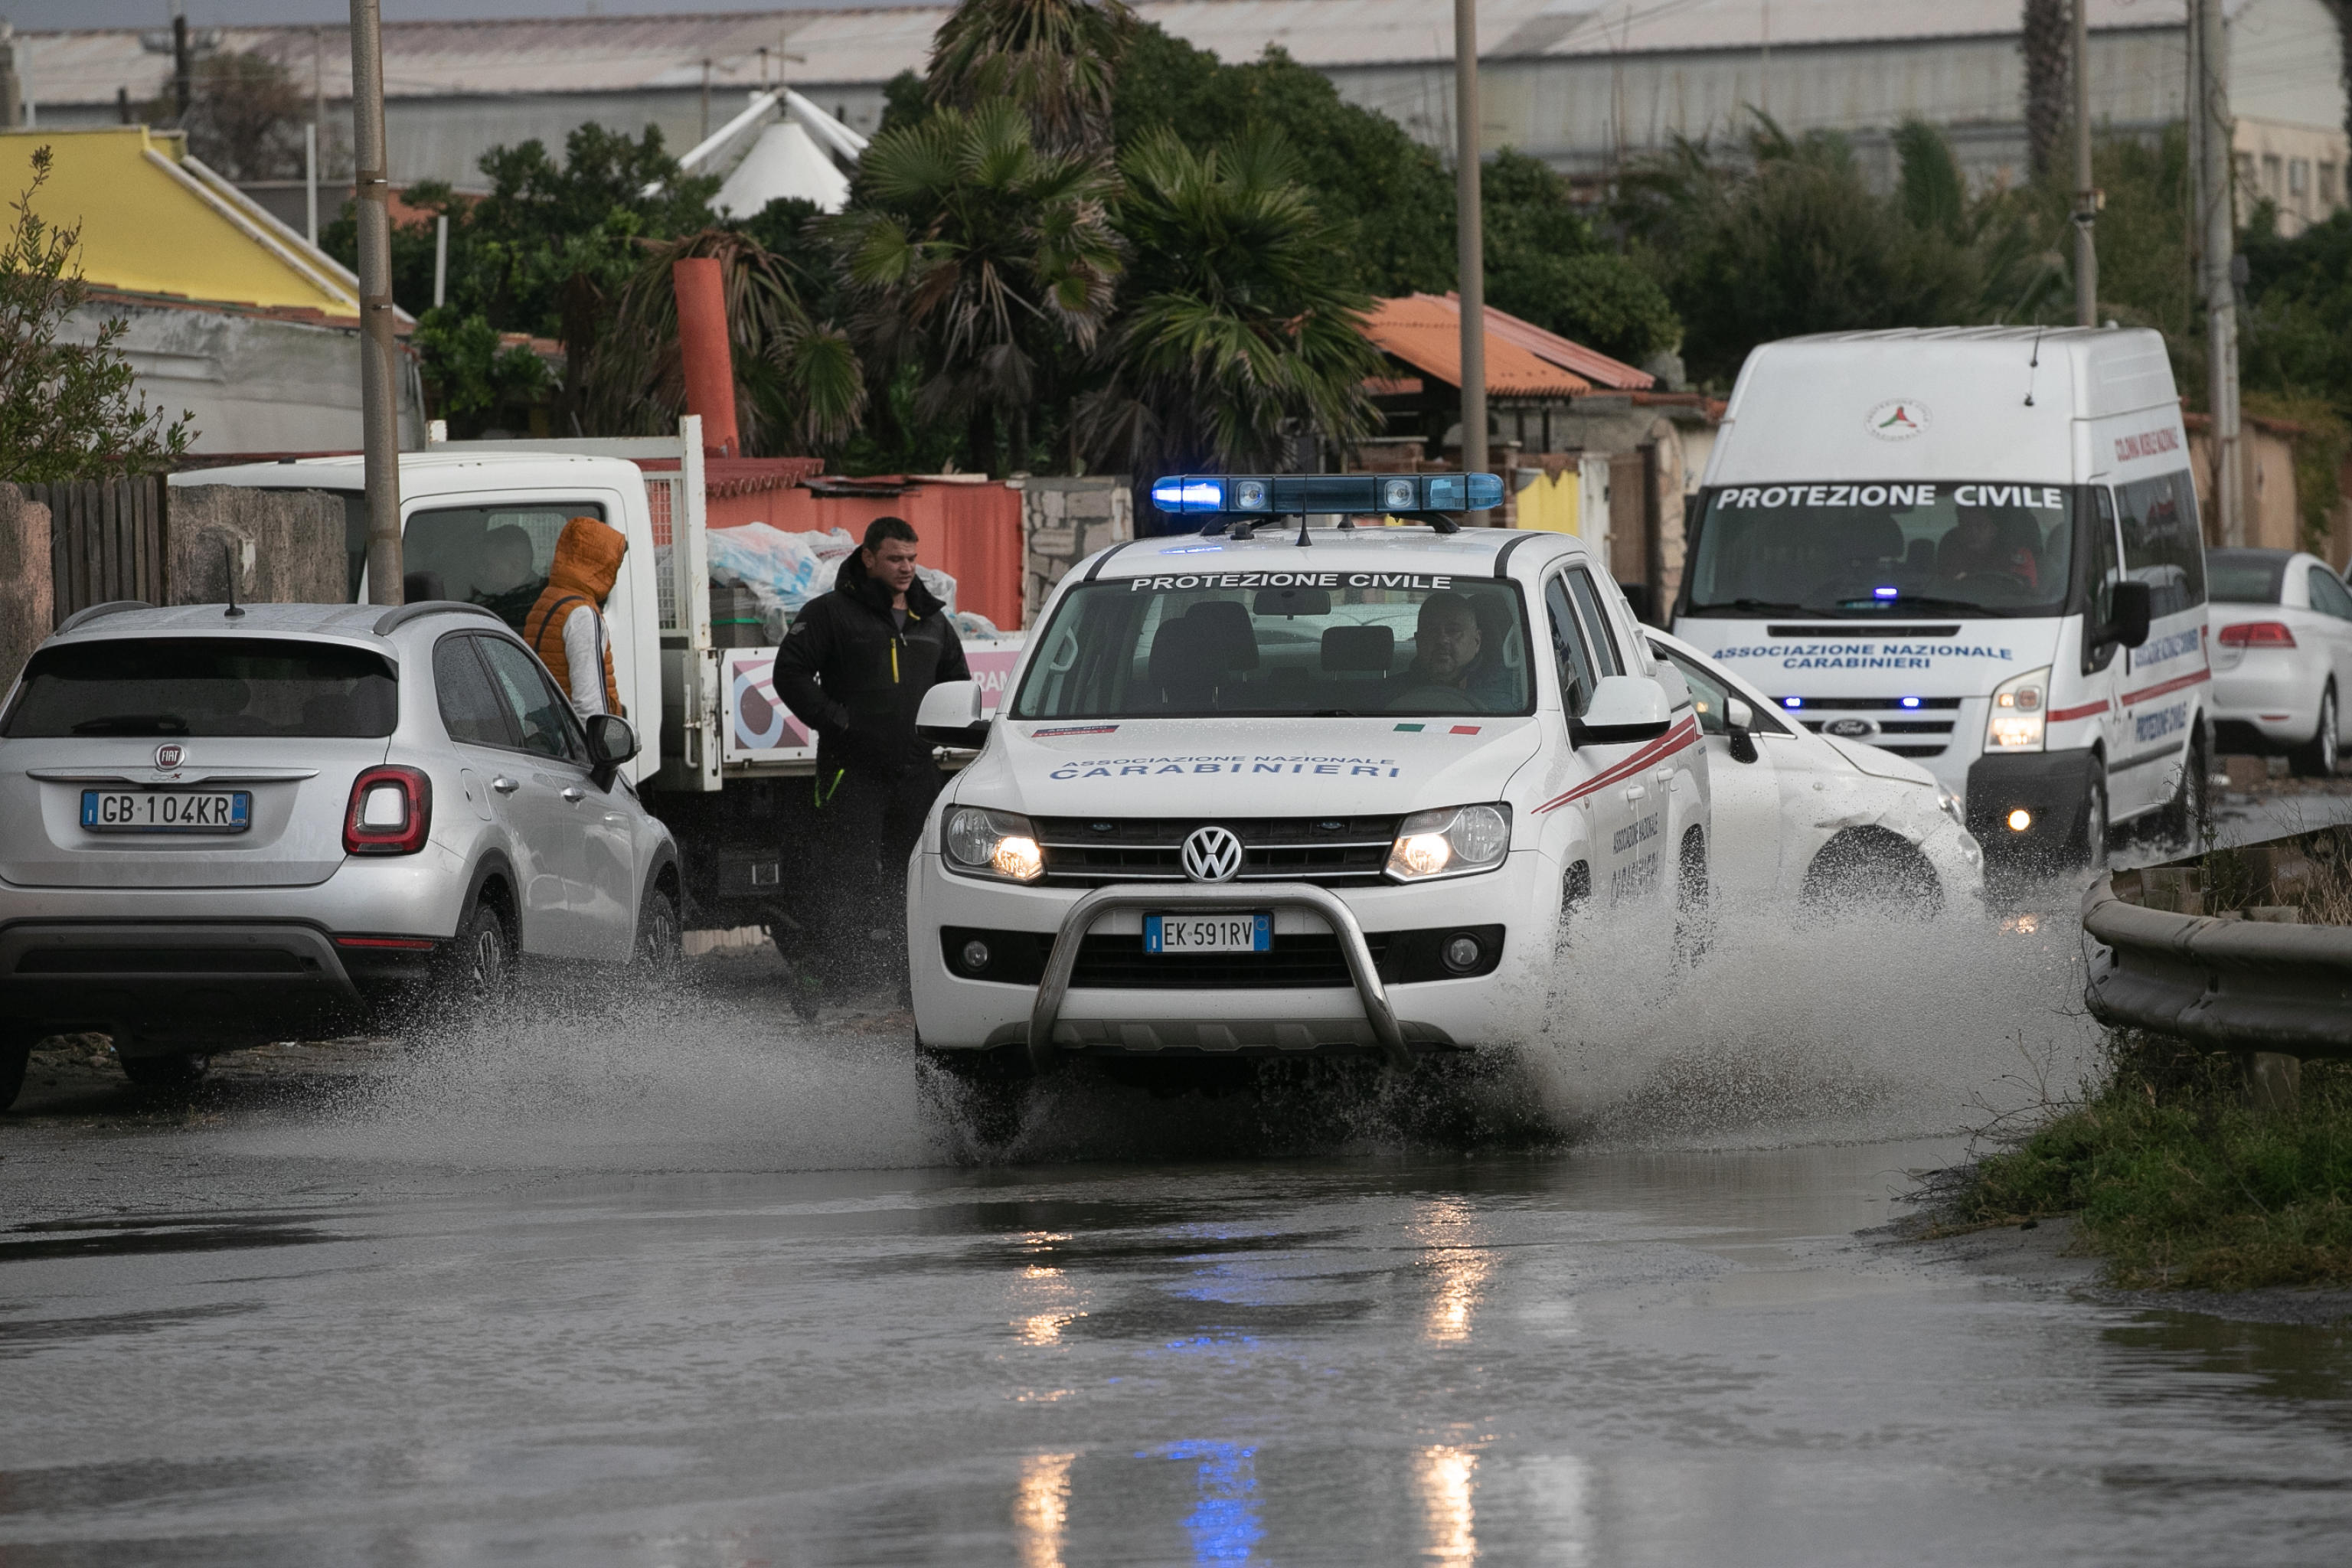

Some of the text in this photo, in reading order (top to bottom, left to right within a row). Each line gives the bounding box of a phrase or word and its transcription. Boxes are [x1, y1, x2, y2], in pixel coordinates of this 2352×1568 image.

[1716, 485, 2063, 510] PROTEZIONE CIVILE
[1131, 573, 1452, 592] PROTEZIONE CIVILE
[1712, 645, 2014, 661] ASSOCIAZIONE NAZIONALE
[1782, 658, 1931, 669] CARABINIERI
[162, 750, 179, 763] FIAT
[1063, 755, 1396, 767] ASSOCIAZIONE NAZIONALE
[1049, 763, 1400, 780] CARABINIERI
[103, 795, 229, 824] GB 104KR
[1164, 921, 1253, 946] EK 591RV
